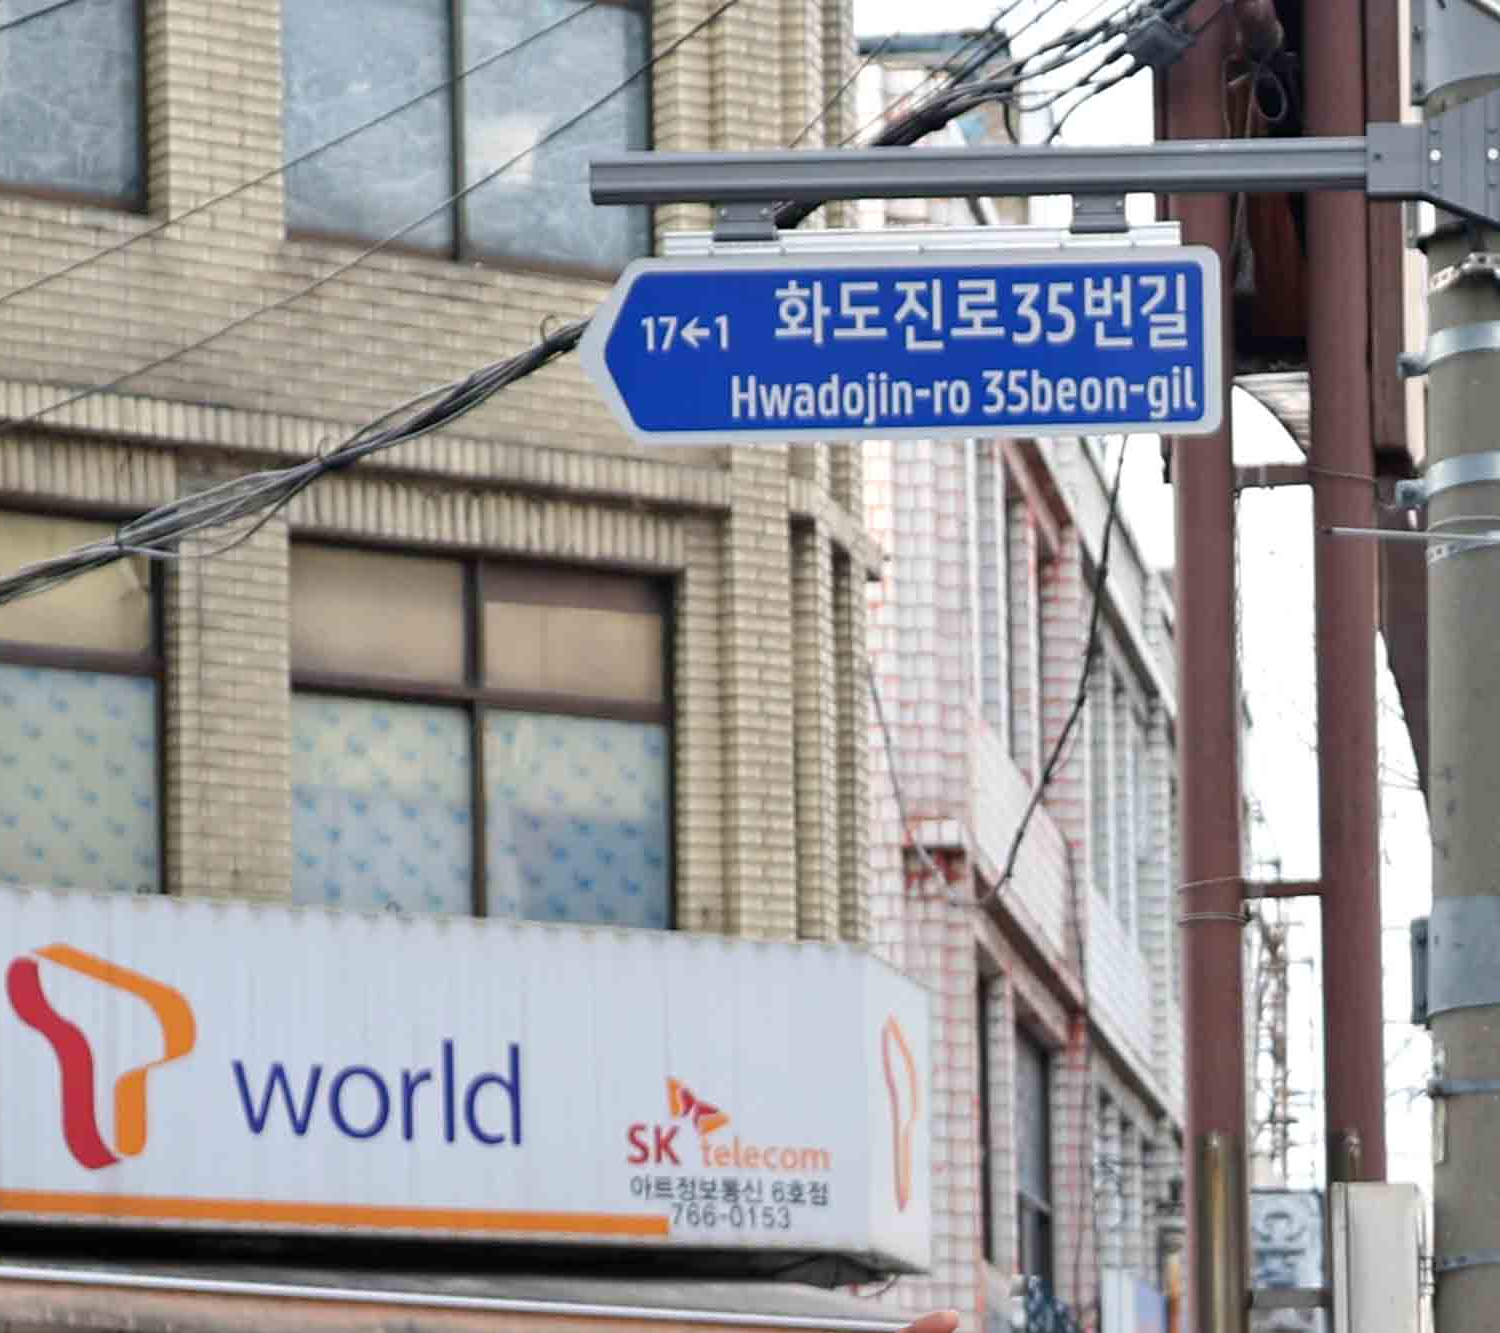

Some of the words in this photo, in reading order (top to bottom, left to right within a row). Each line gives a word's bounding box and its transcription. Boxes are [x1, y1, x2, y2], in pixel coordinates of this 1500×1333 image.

[774, 273, 1189, 352] 화도진로35번길
[731, 371, 970, 425] Hwadojin-ro
[982, 365, 1196, 422] 35beon-gil
[233, 1041, 524, 1147] world
[626, 1121, 682, 1167] SK
[700, 1135, 833, 1170] telecom
[629, 1175, 764, 1204] 아트정보통신
[671, 1202, 792, 1229] 766-0153
